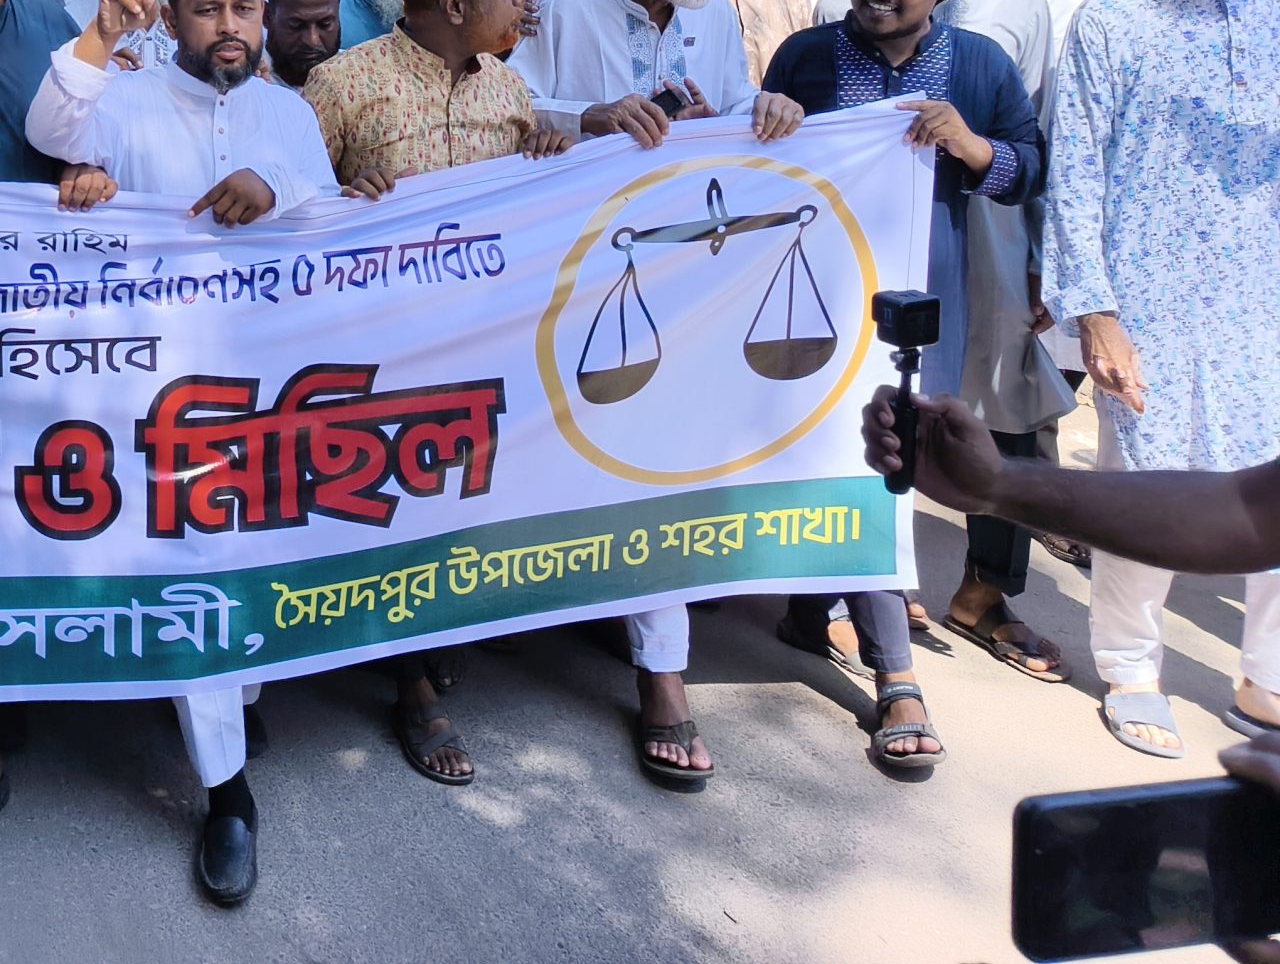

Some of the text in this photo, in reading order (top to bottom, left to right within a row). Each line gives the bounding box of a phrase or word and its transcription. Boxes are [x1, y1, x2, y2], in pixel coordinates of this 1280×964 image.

[36, 226, 131, 254] রাহিম
[323, 242, 394, 293] দফা
[399, 222, 506, 285] দাবিতে
[15, 420, 122, 541] ও
[135, 363, 506, 540] মিছিল
[271, 560, 439, 630] সৈয়দপুর
[446, 533, 614, 596] উপজেলা
[620, 529, 650, 567] ও
[659, 513, 747, 558] শহর
[753, 506, 862, 548] শাখা।
